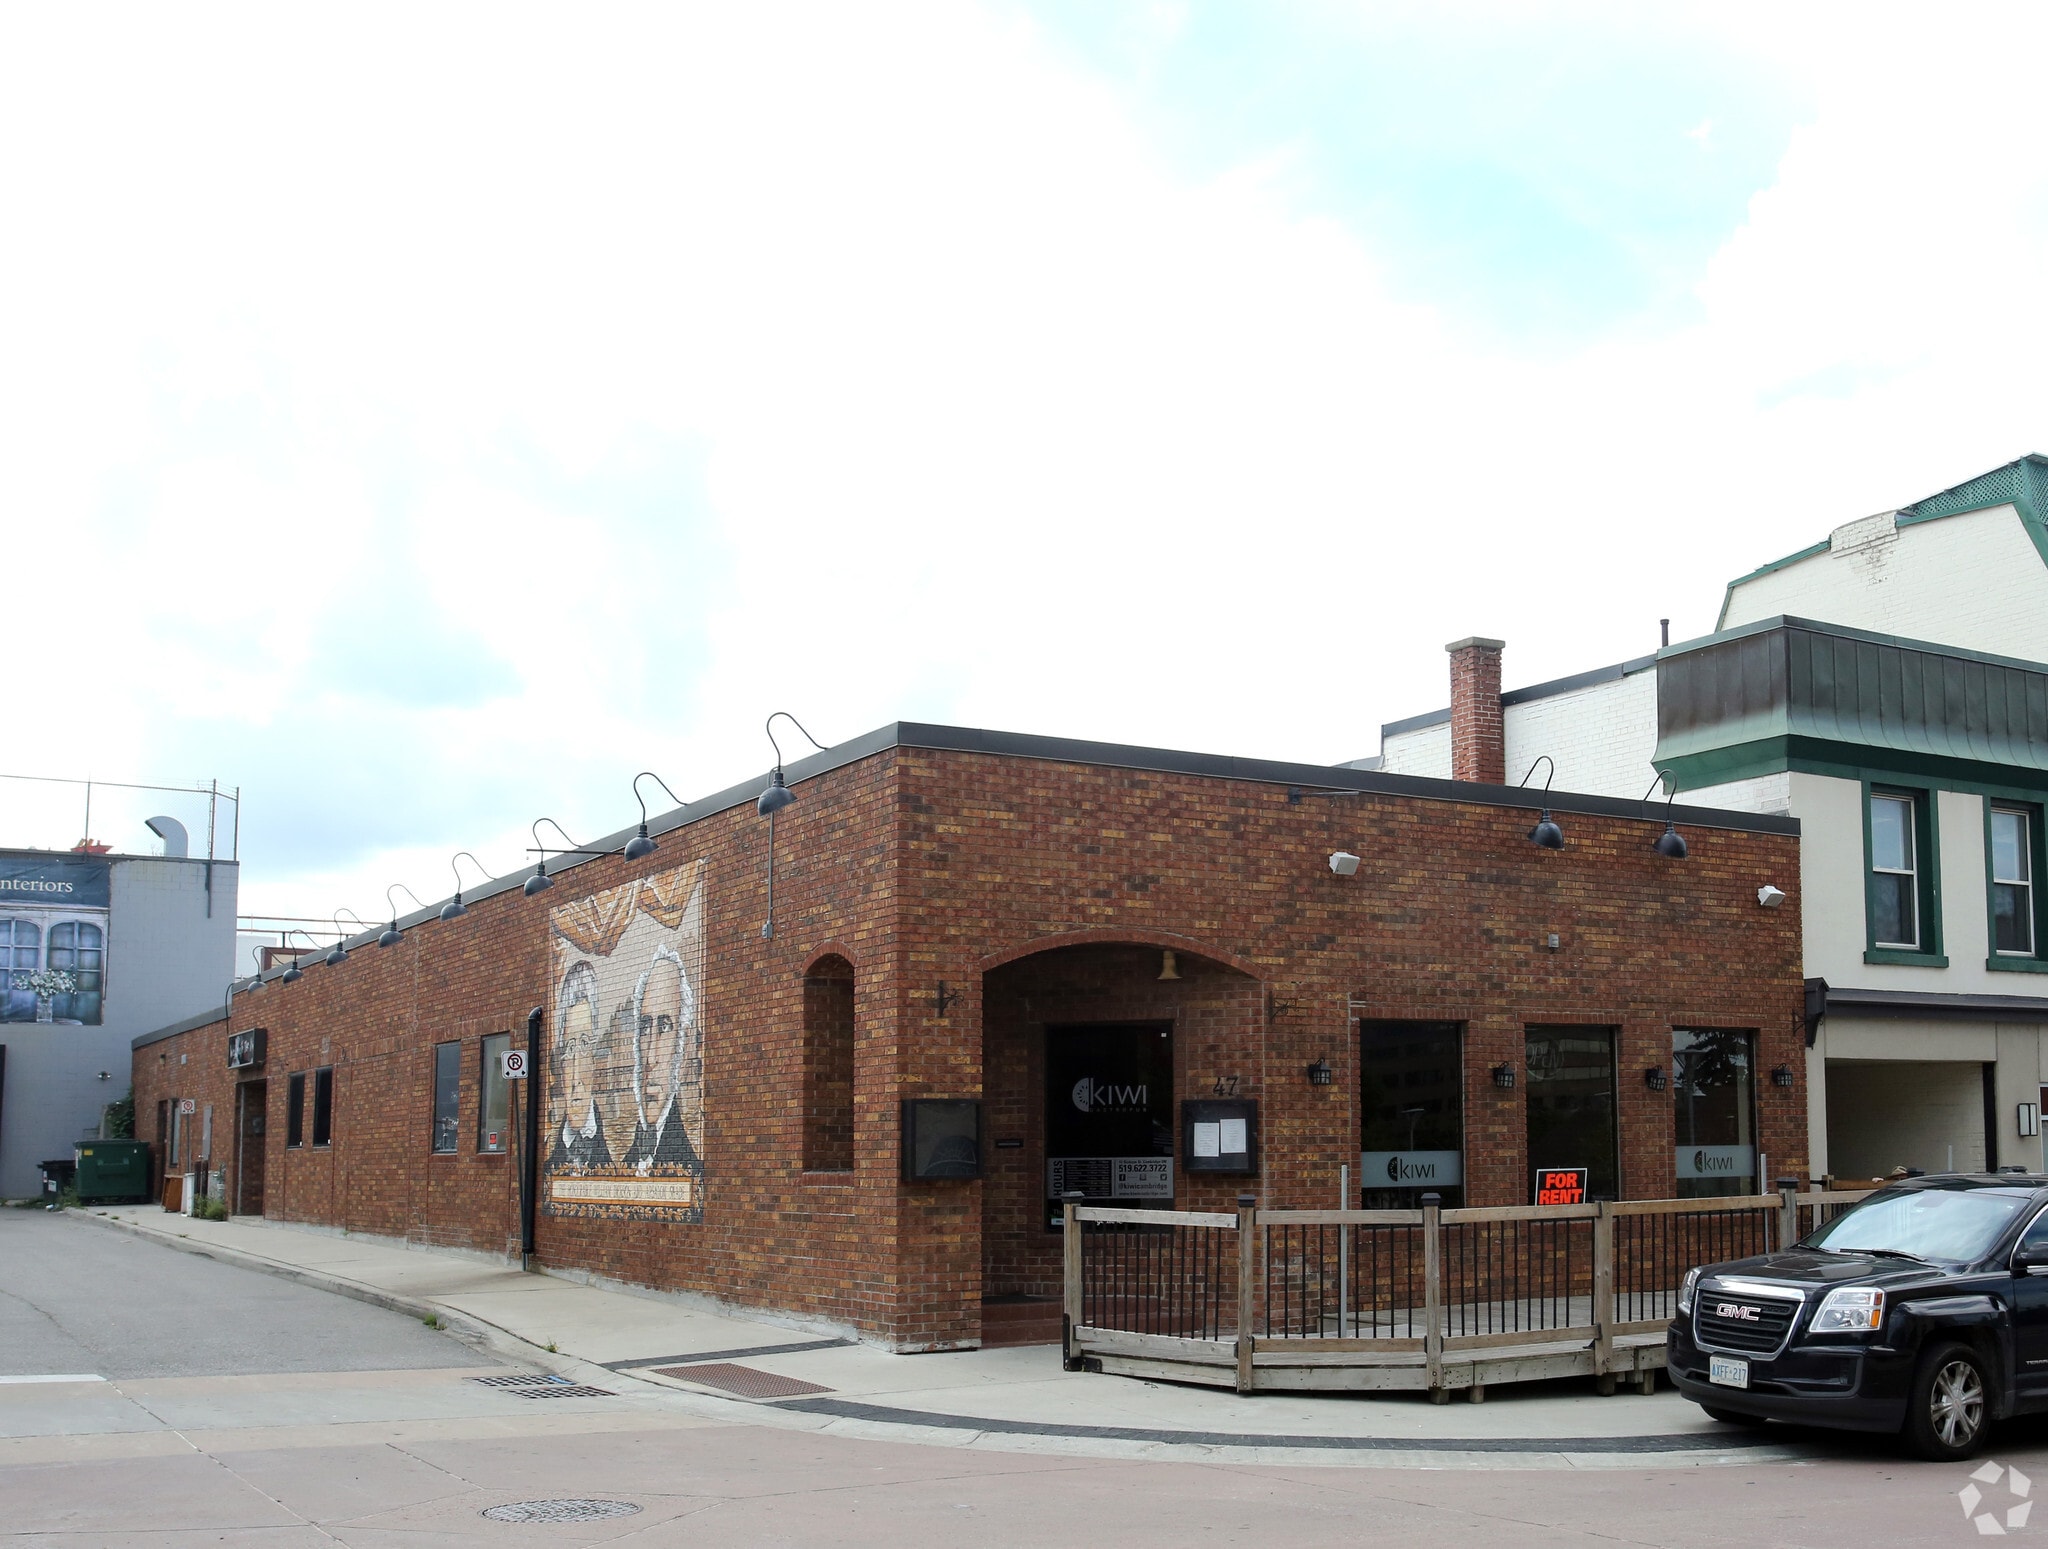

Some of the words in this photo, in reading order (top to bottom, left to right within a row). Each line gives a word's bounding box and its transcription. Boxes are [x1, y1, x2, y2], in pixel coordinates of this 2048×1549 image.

[0, 876, 73, 893] nteriors
[1212, 1075, 1239, 1097] 47
[1118, 1164, 1167, 1173] 519.622.3722
[1053, 1160, 1063, 1196] HOURS
[1545, 1172, 1578, 1190] FOR
[1539, 1188, 1583, 1205] RENT
[1716, 1303, 1761, 1321] GMC
[1733, 1367, 1747, 1382] 217
